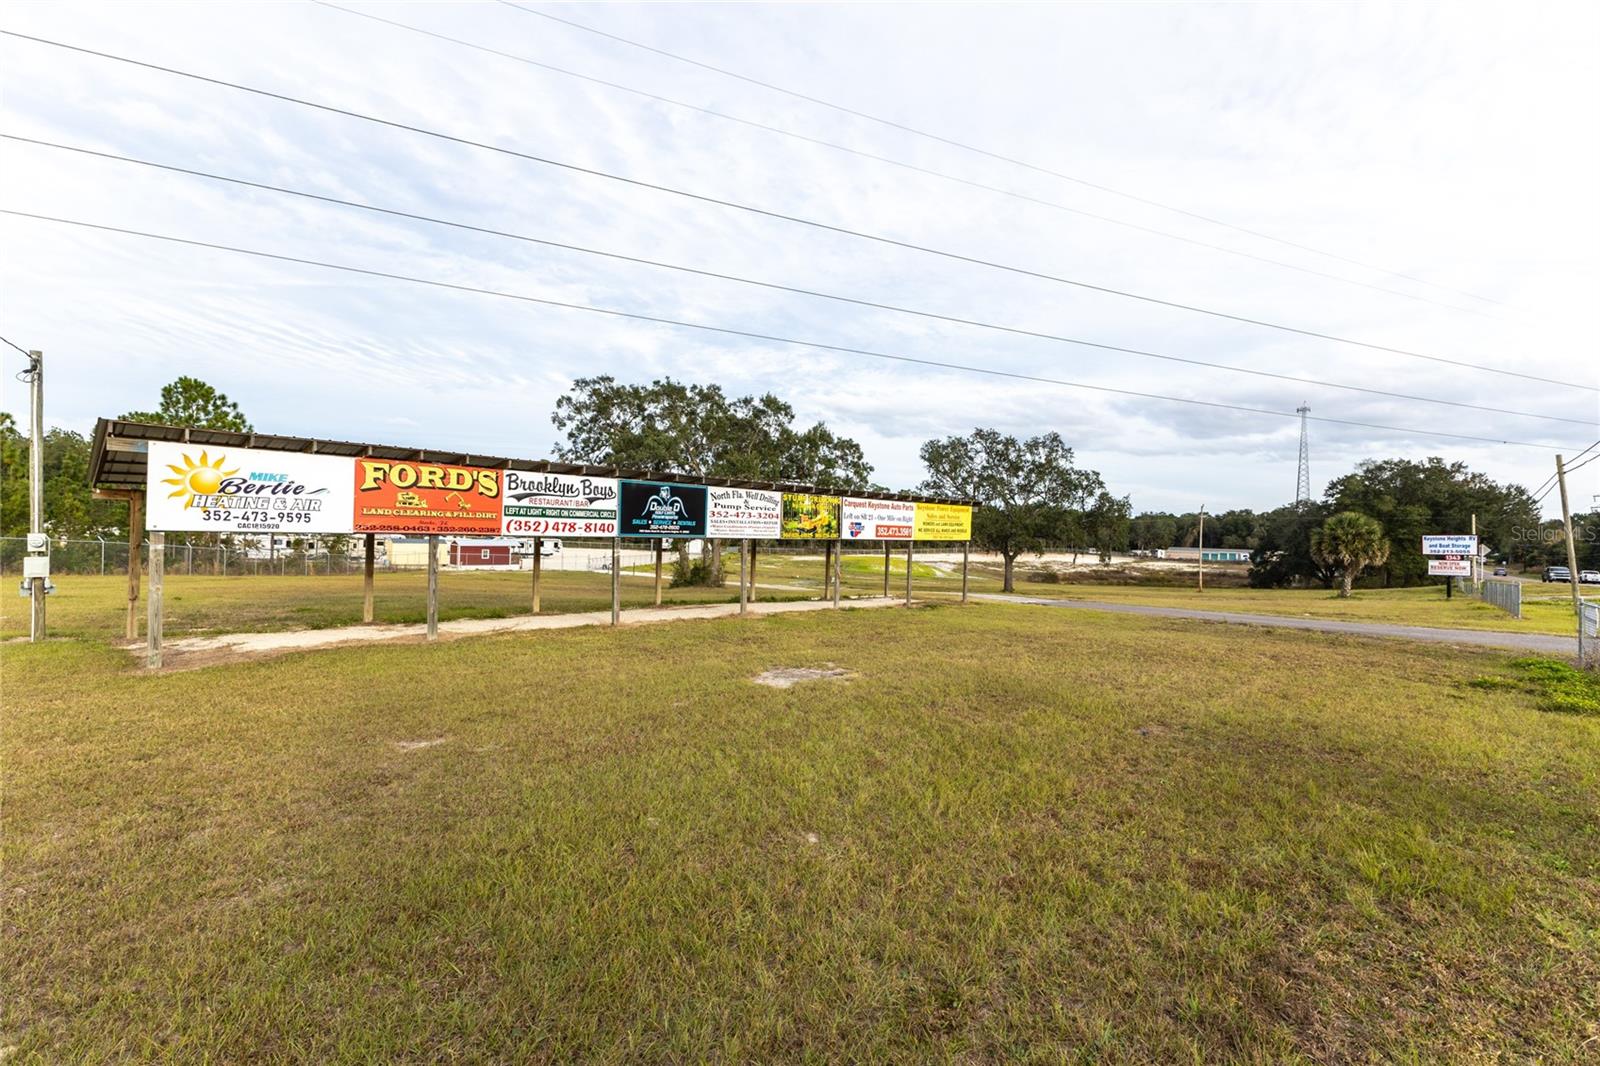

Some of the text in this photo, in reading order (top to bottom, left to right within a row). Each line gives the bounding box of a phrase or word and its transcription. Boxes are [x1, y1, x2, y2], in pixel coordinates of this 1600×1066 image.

[249, 472, 289, 483] MIKE
[360, 461, 500, 499] FORD'S
[505, 473, 617, 500] Brooklyn Boys
[191, 494, 322, 511] HEATING & AIR
[528, 497, 589, 507] RESTAURANT/BAR
[710, 490, 731, 502] North
[732, 490, 744, 499] Fla.
[745, 491, 759, 500] Well
[760, 493, 780, 507] Drilling
[650, 502, 680, 512] Double D
[714, 502, 742, 511] Pump
[844, 499, 914, 511] Carquest Keystone Auto Parts
[203, 510, 311, 523] 352-473-9595
[363, 507, 393, 516] LAND
[393, 508, 445, 518] CLEARING
[453, 511, 475, 519] FILL
[475, 512, 498, 520] DIRT
[505, 507, 616, 518] LEFT AT LIGHT RIGHT ON COMMERCIAL CIRCLE
[709, 510, 779, 519] 352-473-3204
[506, 519, 615, 534] (352) 478-8140
